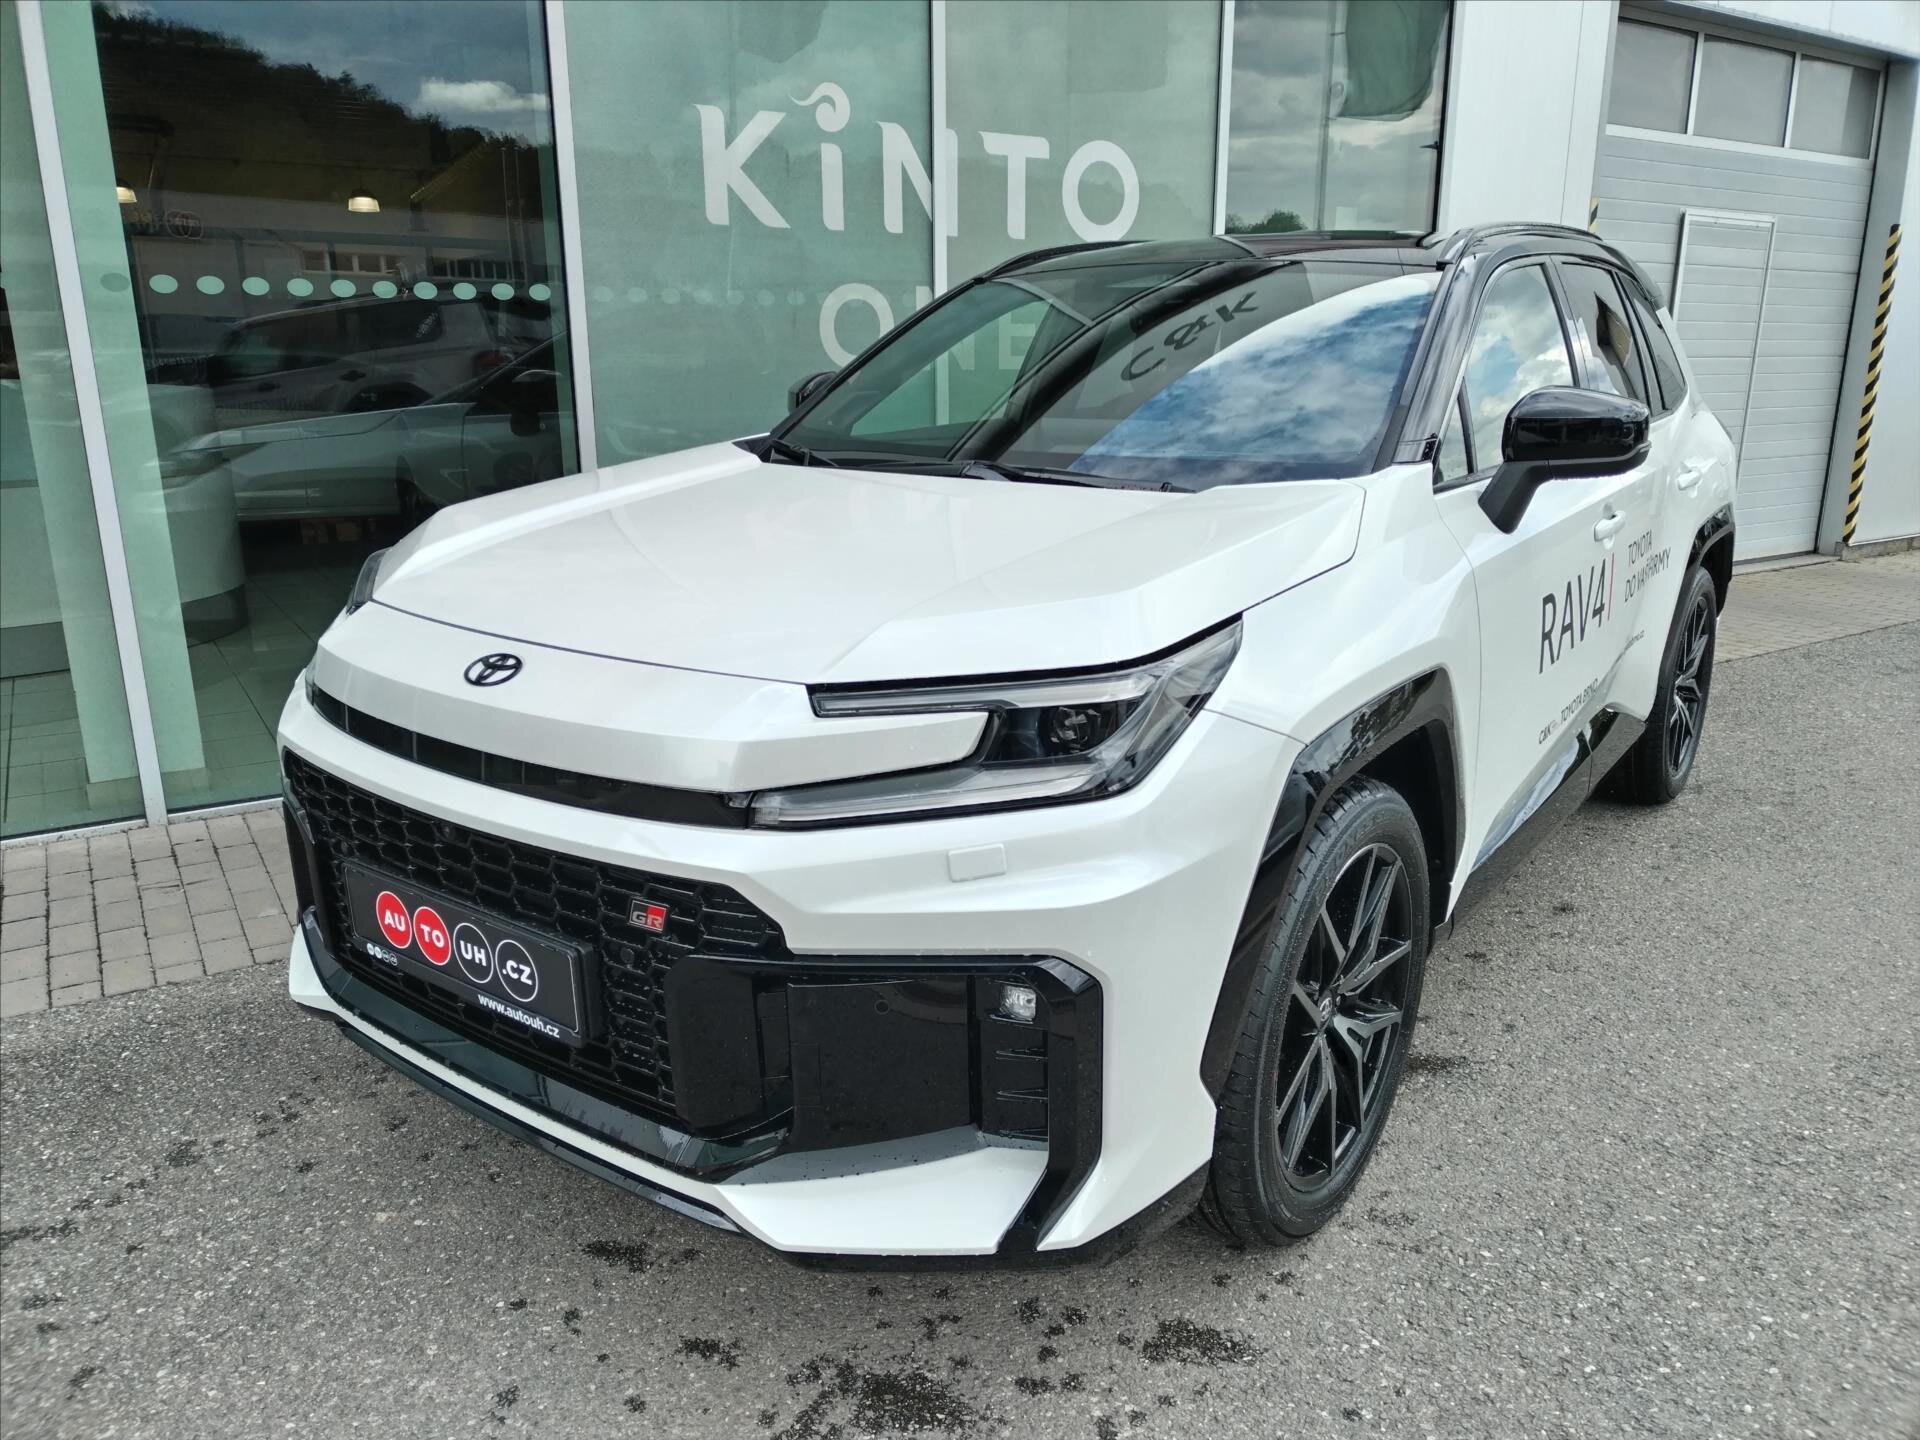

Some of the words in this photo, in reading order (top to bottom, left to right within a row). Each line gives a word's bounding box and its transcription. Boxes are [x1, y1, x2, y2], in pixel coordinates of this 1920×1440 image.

[1628, 531, 1653, 567] TOYOTA
[1624, 574, 1636, 603] DO
[1538, 559, 1606, 674] RAV4
[1560, 692, 1582, 721] TOYOTA
[632, 909, 664, 929] GR
[383, 909, 406, 932] AU
[420, 923, 445, 948] TO
[460, 940, 487, 967] UH
[502, 960, 534, 986] .CZ
[478, 992, 560, 1038] www.autouh.cz
